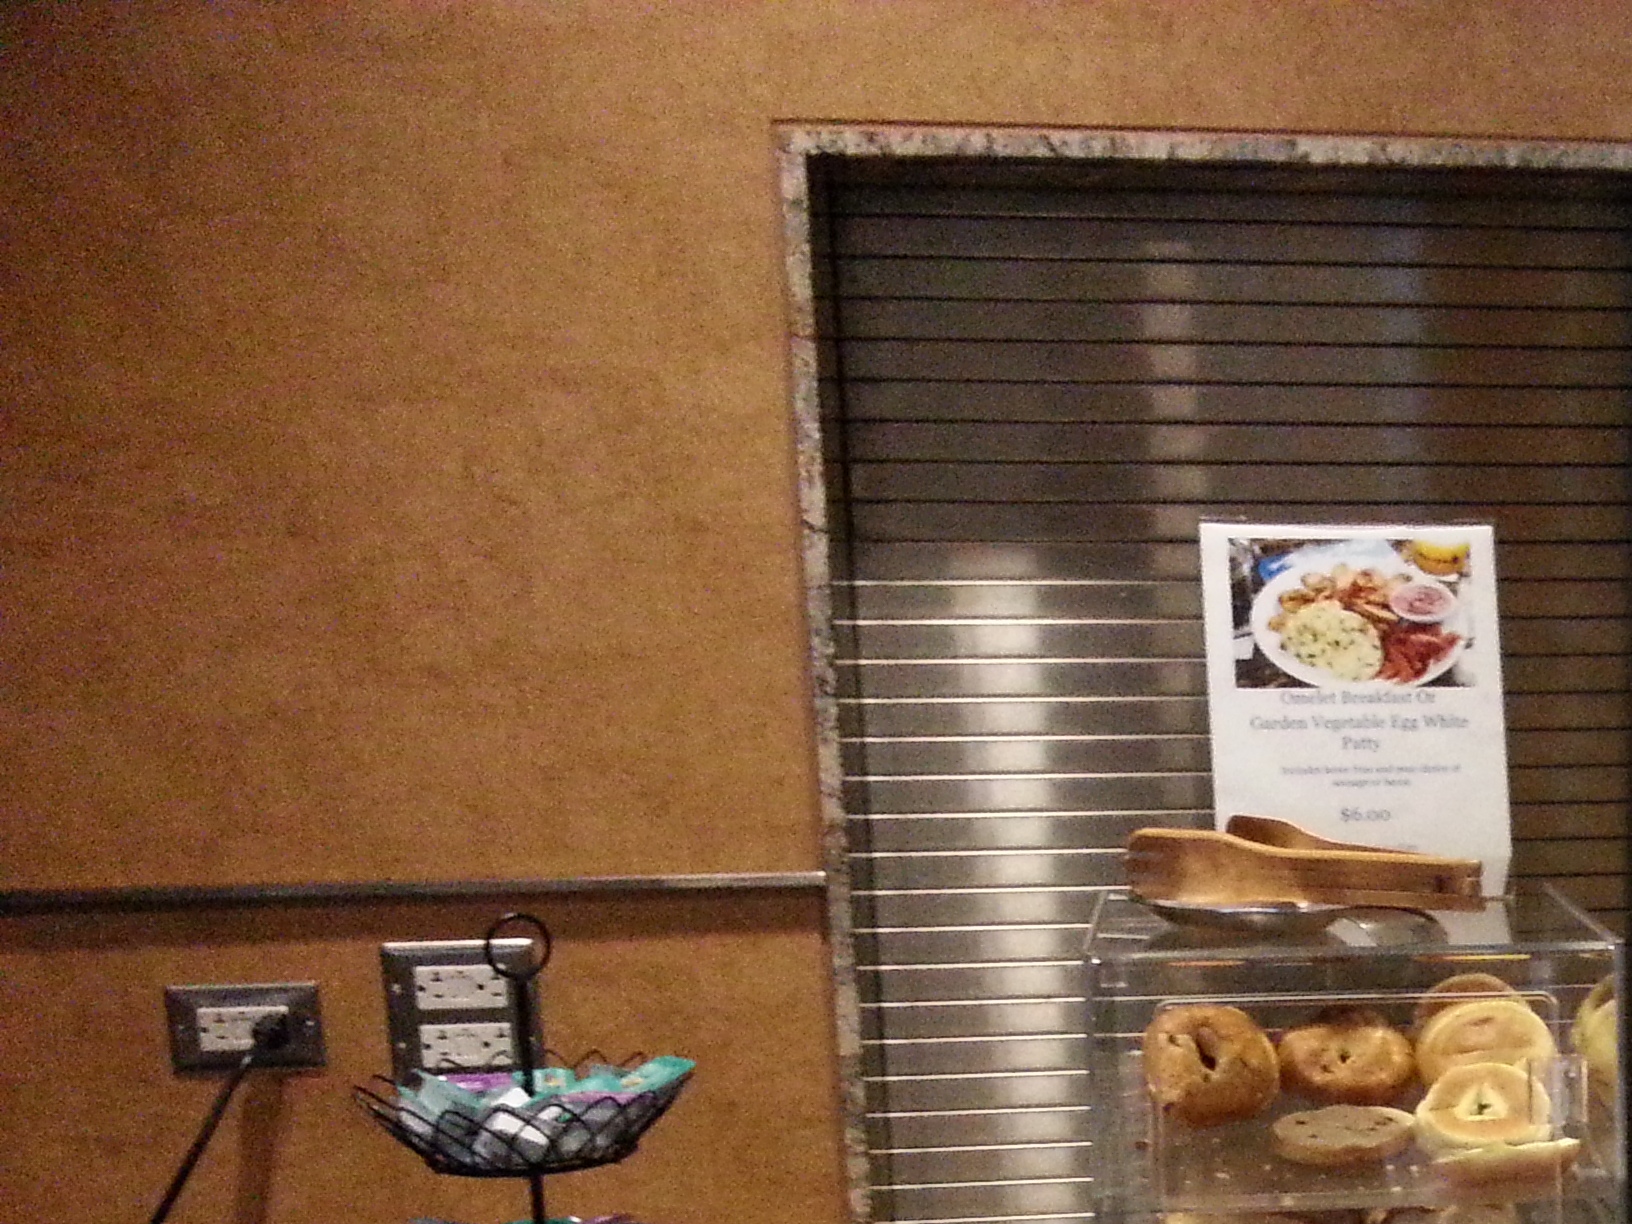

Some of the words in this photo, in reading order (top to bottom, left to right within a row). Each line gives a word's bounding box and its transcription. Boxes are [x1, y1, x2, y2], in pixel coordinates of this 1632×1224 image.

[1249, 715, 1308, 730] Garden
[1312, 714, 1385, 732] Vegetable
[1391, 713, 1419, 732] Egg
[1423, 713, 1470, 729] White
[1342, 736, 1380, 753] Patty
